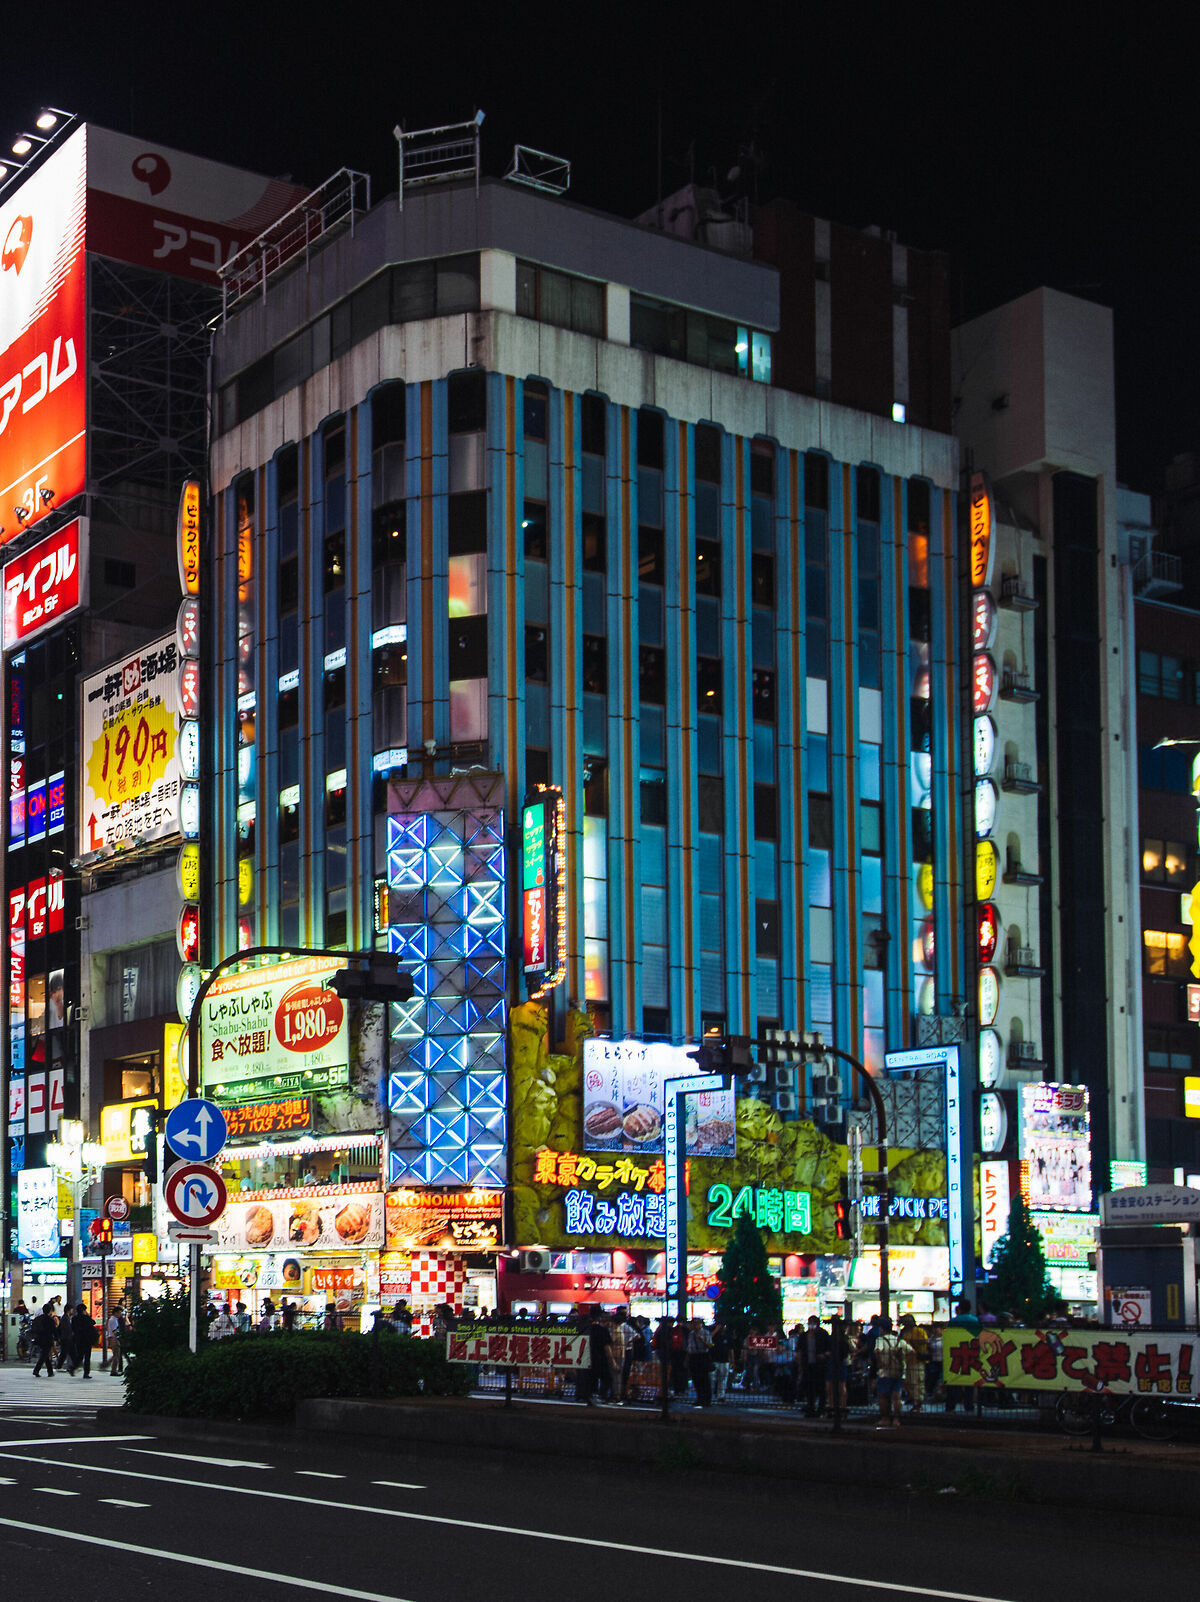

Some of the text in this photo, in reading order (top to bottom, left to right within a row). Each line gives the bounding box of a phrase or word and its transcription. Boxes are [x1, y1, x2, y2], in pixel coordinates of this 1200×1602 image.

[22, 474, 49, 521] 3F
[6, 544, 77, 612] アイフル
[45, 593, 59, 617] 5F
[102, 716, 168, 782] 190円
[208, 989, 273, 1022] しゃぶしゃぶ
[283, 1007, 327, 1045] 1,980
[329, 1066, 347, 1085] 5F
[249, 1118, 273, 1132] パスタ
[534, 1148, 690, 1196] 東京カラオケ本
[668, 1111, 676, 1208] GODZILLA
[387, 1193, 500, 1207] OKONOMI YAKI
[565, 1189, 667, 1239] 飲み放題
[708, 1183, 812, 1235] 24時間
[985, 1169, 998, 1232] トラノコ
[668, 1219, 676, 1265] ROAD
[511, 1325, 531, 1334] street
[532, 1326, 540, 1334] is
[950, 1338, 1194, 1382] ポイ捨て禁止!
[1139, 1378, 1192, 1393] 新宿区
